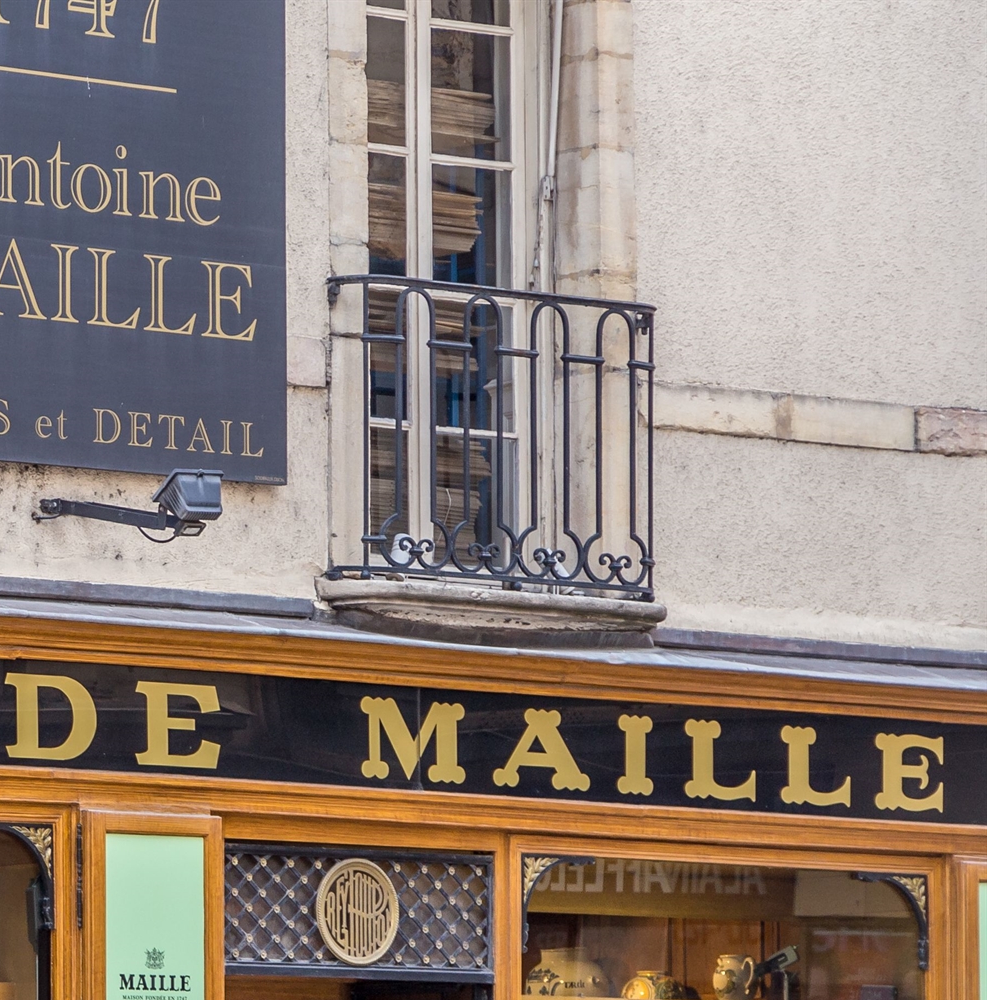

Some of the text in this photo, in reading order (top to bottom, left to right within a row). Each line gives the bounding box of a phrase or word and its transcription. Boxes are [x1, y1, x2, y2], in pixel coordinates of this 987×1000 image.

[35, 409, 68, 440] et
[93, 408, 264, 458] DETAIL
[360, 696, 945, 814] MAILLE
[119, 973, 191, 992] MAILLE
